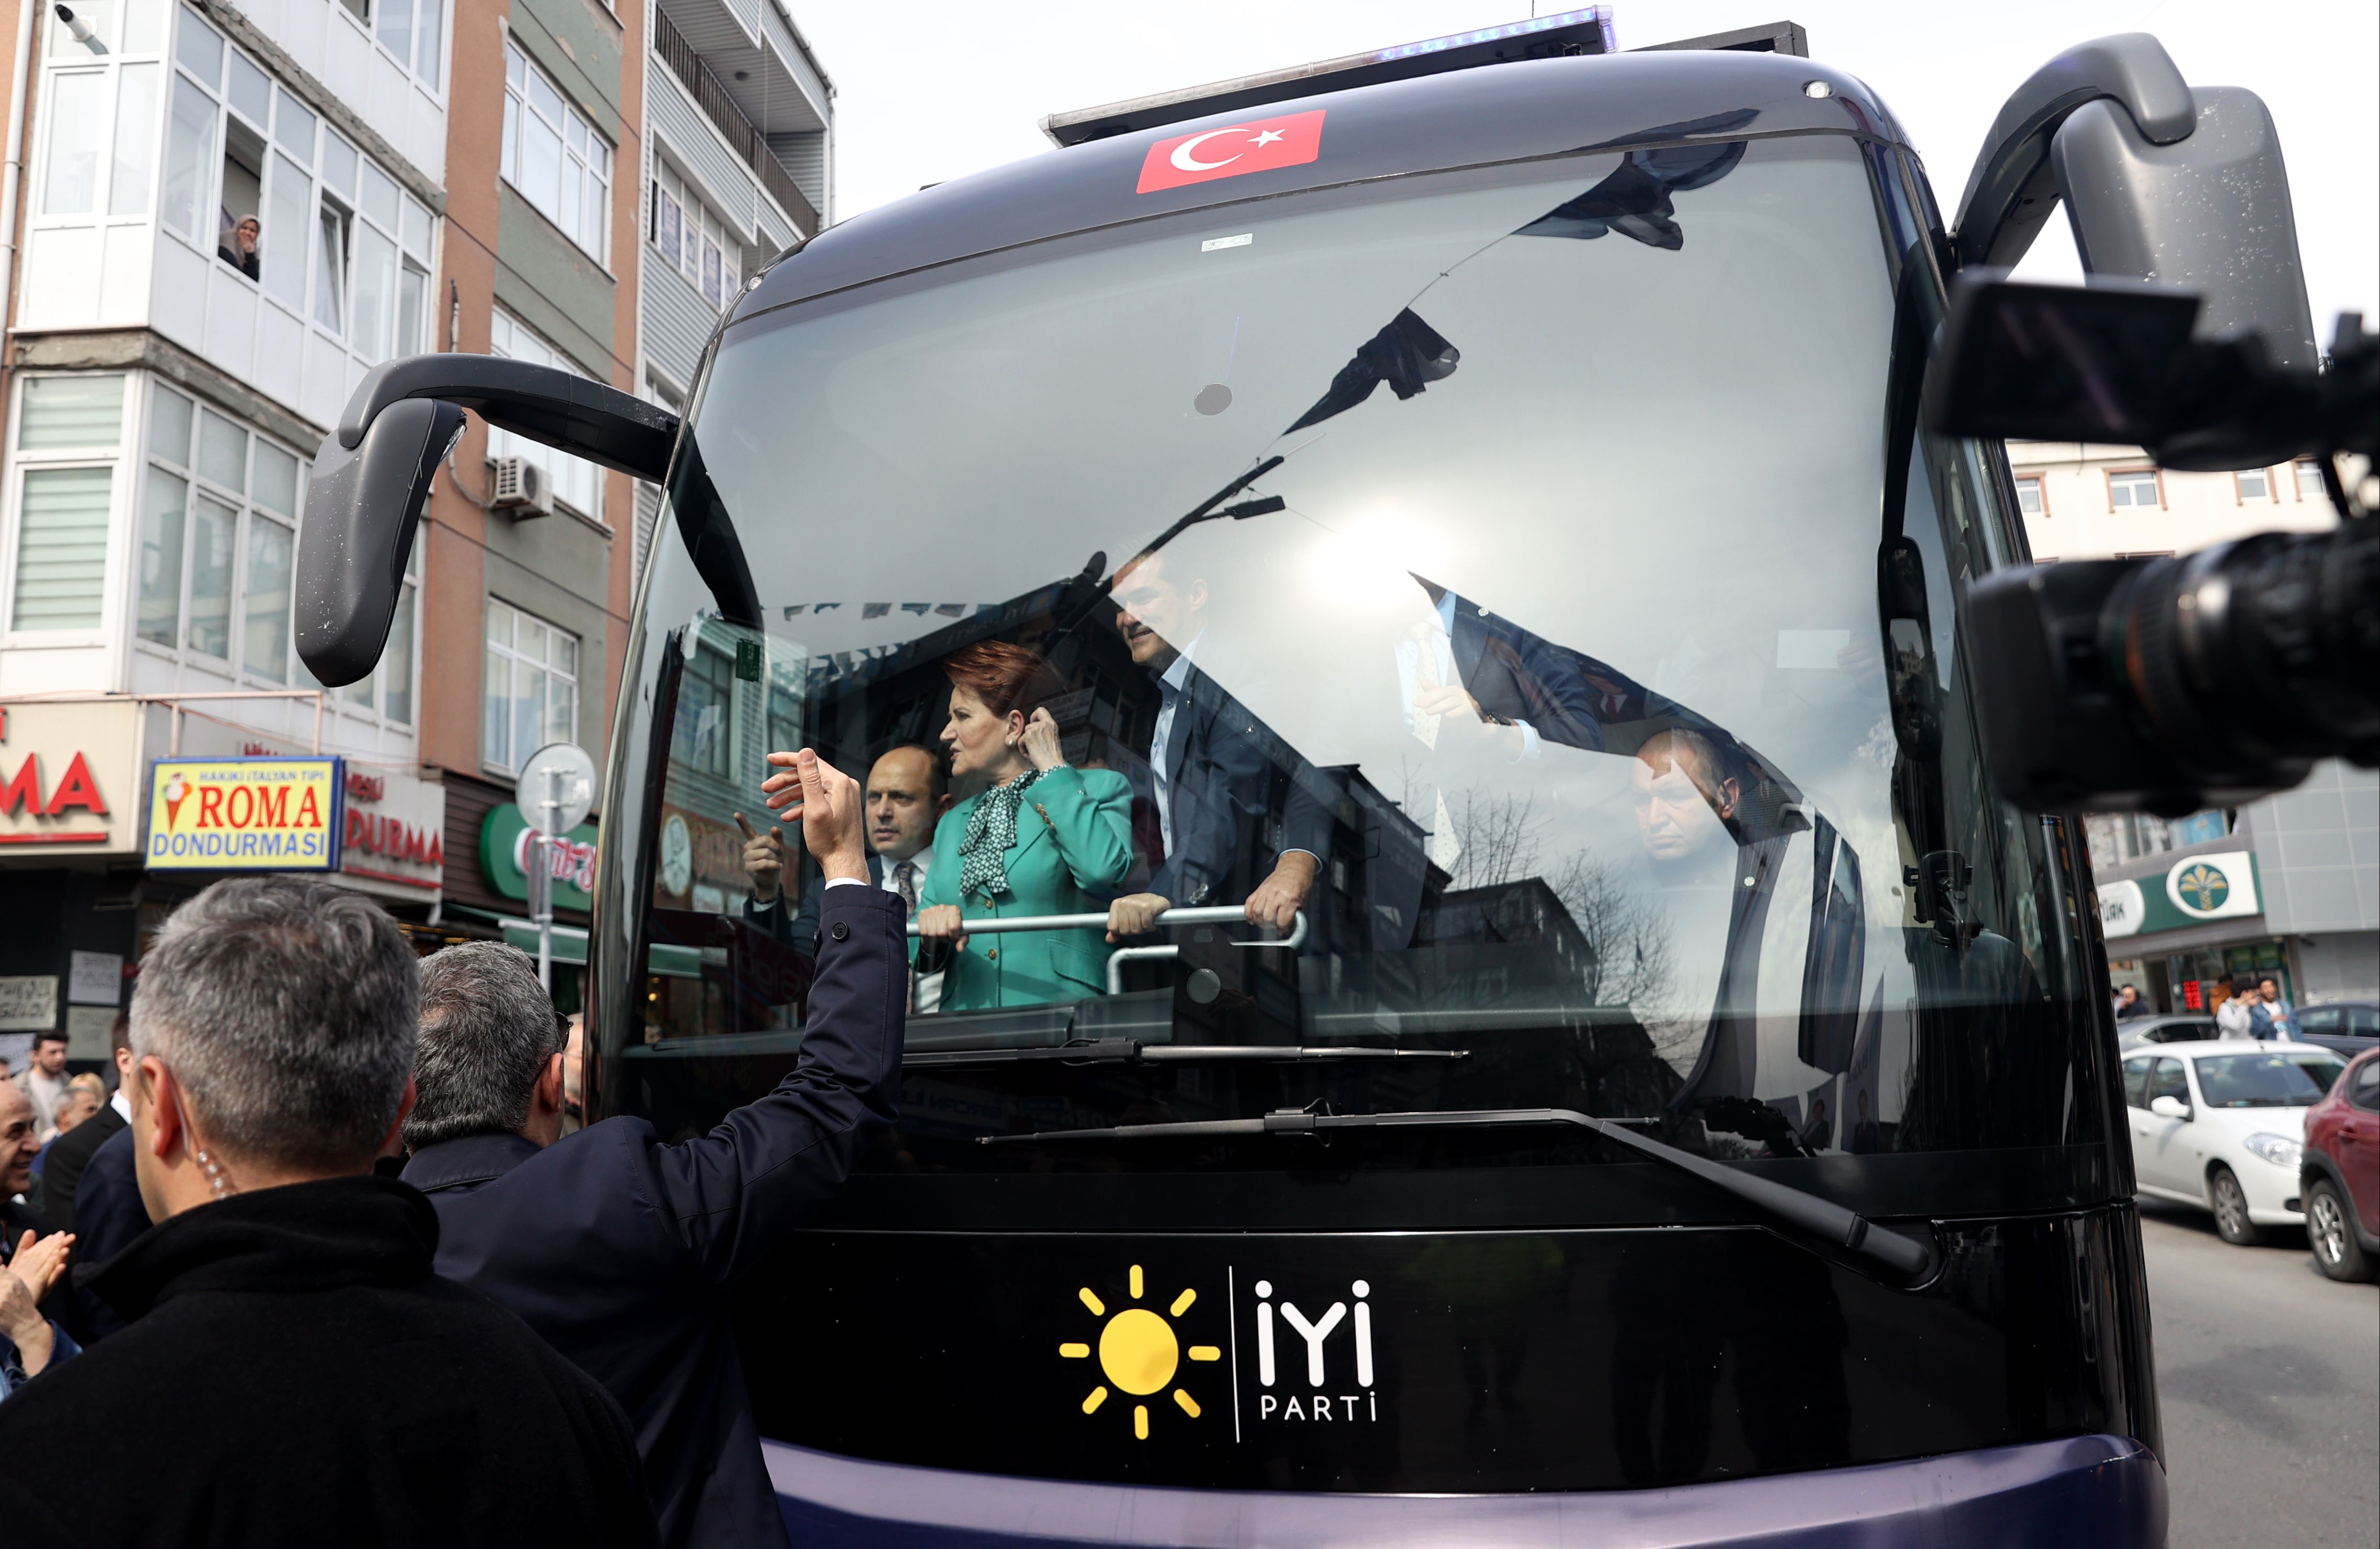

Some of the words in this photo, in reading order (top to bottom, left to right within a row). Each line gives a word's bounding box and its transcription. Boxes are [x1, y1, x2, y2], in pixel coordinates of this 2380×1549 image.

[196, 784, 322, 828] ROMA
[153, 833, 325, 857] DONDURMASI
[345, 807, 445, 866] DURMA
[2099, 899, 2125, 922] ÜRK
[1255, 1279, 1374, 1388] İYİ
[1261, 1391, 1376, 1421] PARTİ
